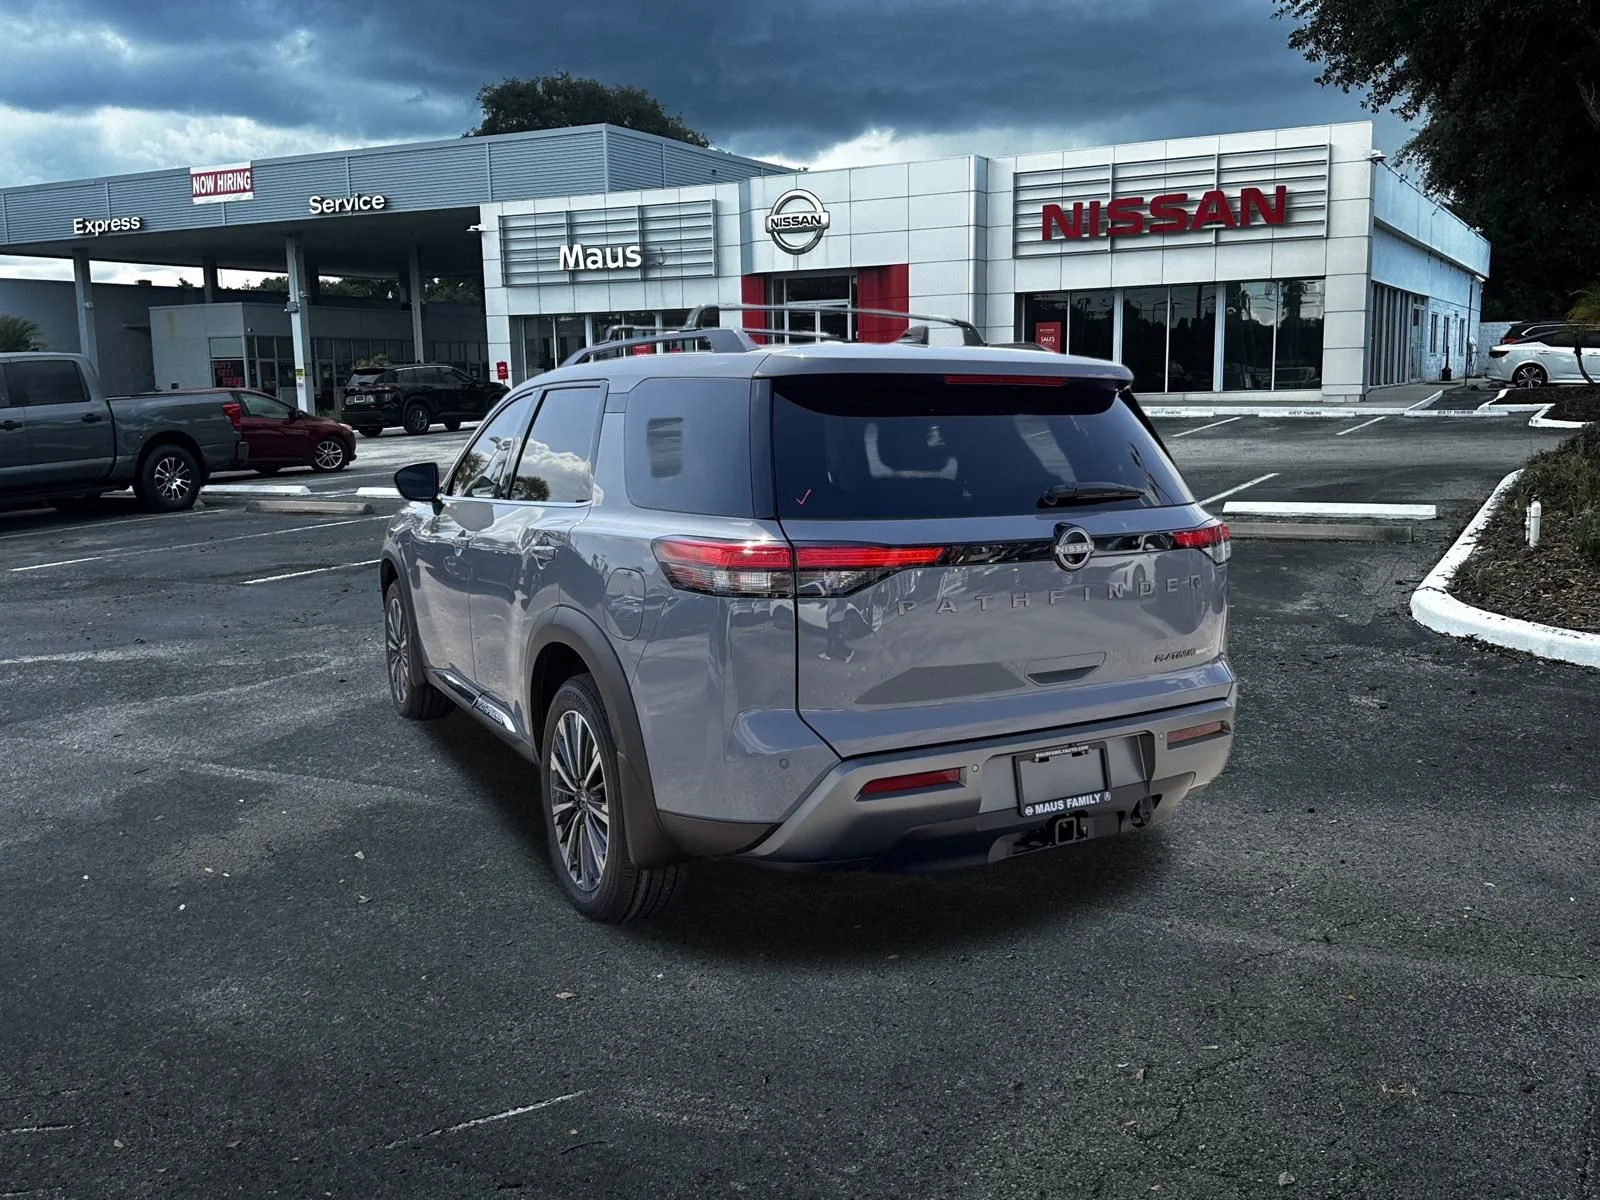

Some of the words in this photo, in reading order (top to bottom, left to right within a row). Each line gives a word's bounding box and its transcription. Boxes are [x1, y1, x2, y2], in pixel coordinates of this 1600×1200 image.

[192, 175, 215, 194] NOW
[216, 171, 251, 192] HIRING
[308, 193, 385, 215] Service
[1042, 185, 1287, 241] NISSAN
[73, 215, 141, 237] Express
[770, 214, 823, 229] NISSAN
[559, 243, 642, 271] Maus
[1056, 544, 1094, 553] NISSAN
[897, 574, 1202, 616] PATHFINDER
[1153, 647, 1197, 662] PLATINUM
[1035, 800, 1064, 814] MAUS
[1066, 793, 1101, 809] FAMILY
